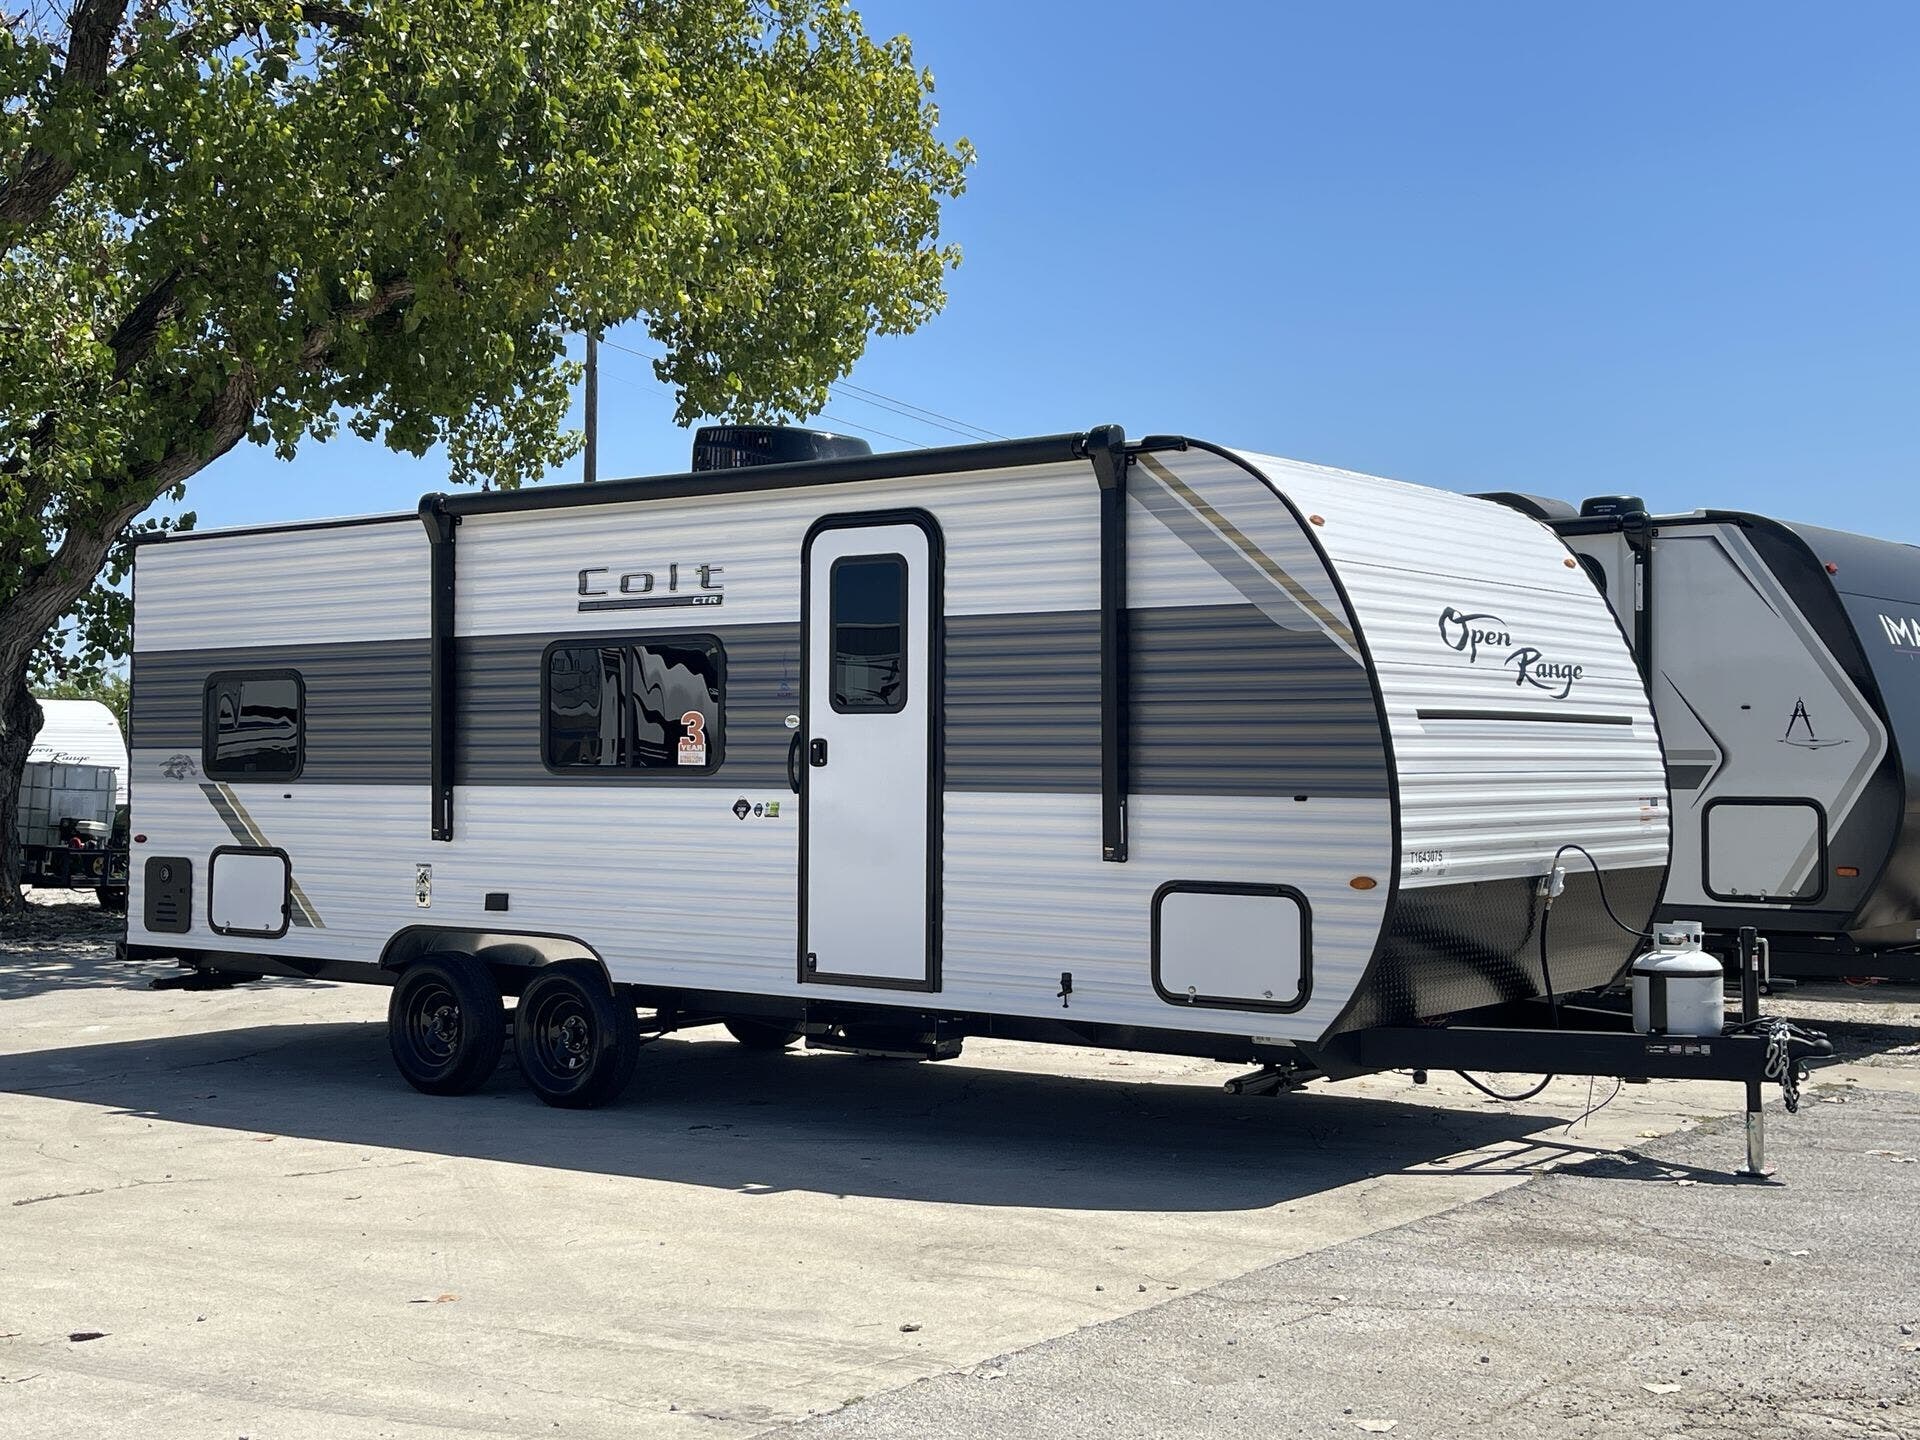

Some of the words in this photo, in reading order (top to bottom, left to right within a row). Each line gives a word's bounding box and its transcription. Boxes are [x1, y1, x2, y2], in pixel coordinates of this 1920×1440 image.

[577, 562, 724, 596] Colt
[692, 596, 718, 605] CTR
[1438, 606, 1512, 664] Open
[1504, 647, 1584, 700] Range
[680, 710, 705, 746] 3
